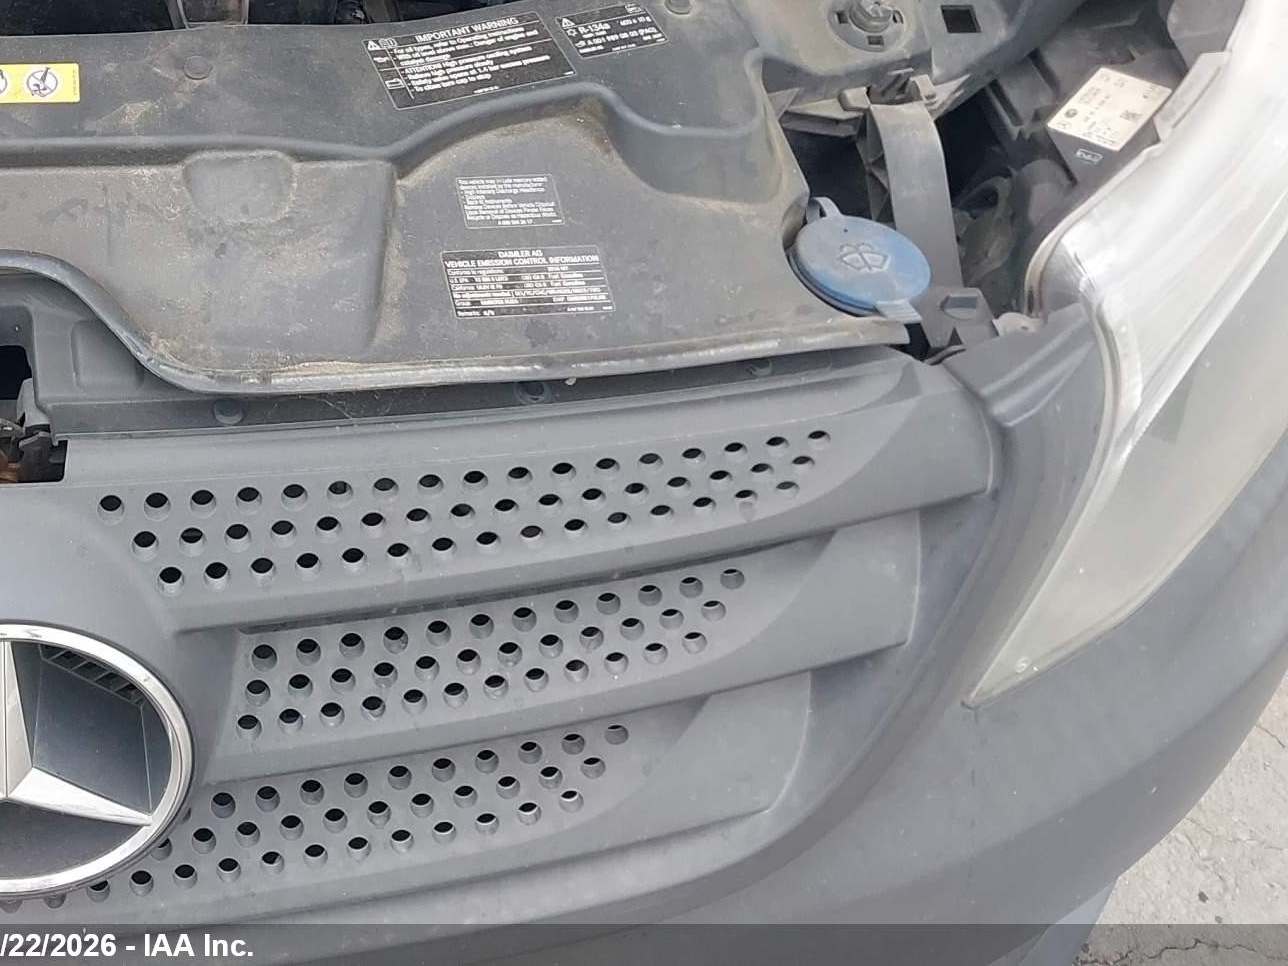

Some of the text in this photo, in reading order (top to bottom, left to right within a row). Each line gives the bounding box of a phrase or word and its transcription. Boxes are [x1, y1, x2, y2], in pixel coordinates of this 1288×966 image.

[415, 18, 520, 43] IMPORTANT WARNING
[577, 22, 612, 35] R-134a
[456, 34, 489, 44] Operating
[473, 38, 498, 48] Danger
[446, 64, 475, 75] pressure
[445, 255, 599, 268] VEHICLE EMISSION CONTROL INFORMATION
